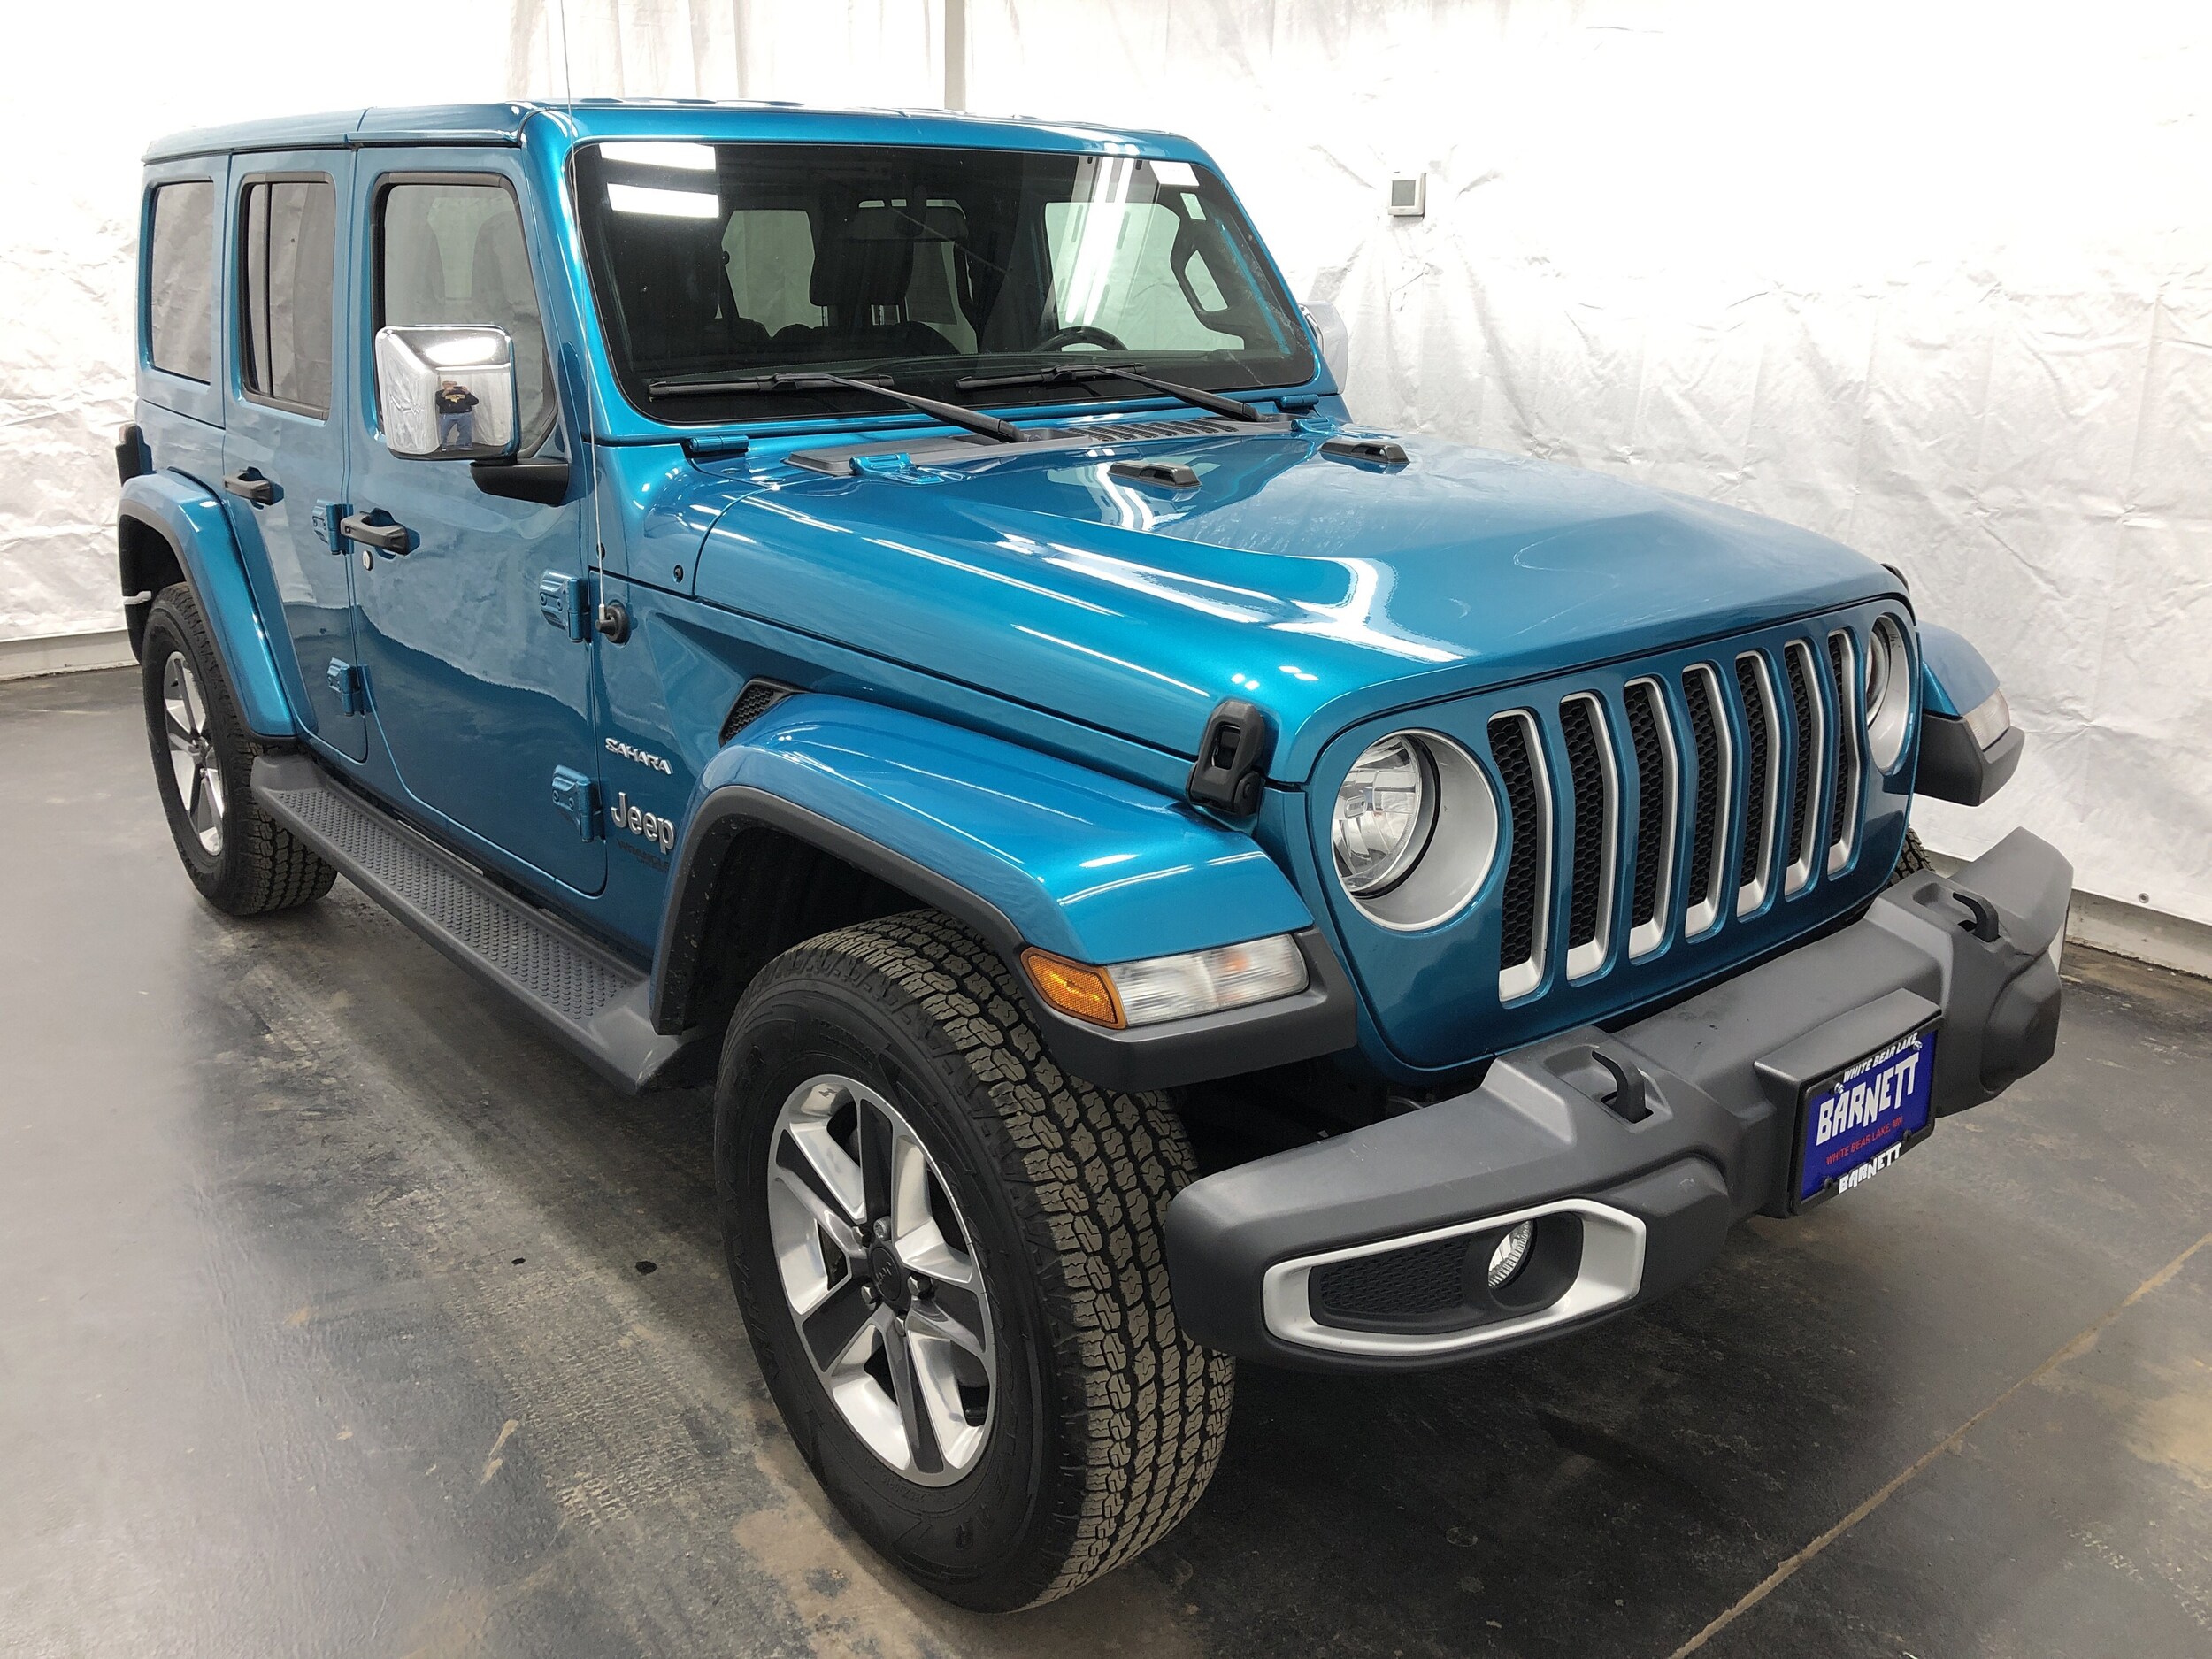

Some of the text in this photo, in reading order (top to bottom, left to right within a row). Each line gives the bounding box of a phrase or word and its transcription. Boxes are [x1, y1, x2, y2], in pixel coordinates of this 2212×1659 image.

[605, 738, 673, 775] SAHARA
[611, 792, 675, 855] Jeep
[1843, 1032, 1918, 1083] WHITE BEAR LAKE
[1816, 1052, 1919, 1146] BARNETT
[1826, 1146, 1849, 1165] WHITE
[1851, 1134, 1871, 1153] BEAR
[1839, 1142, 1901, 1194] BARNETT
